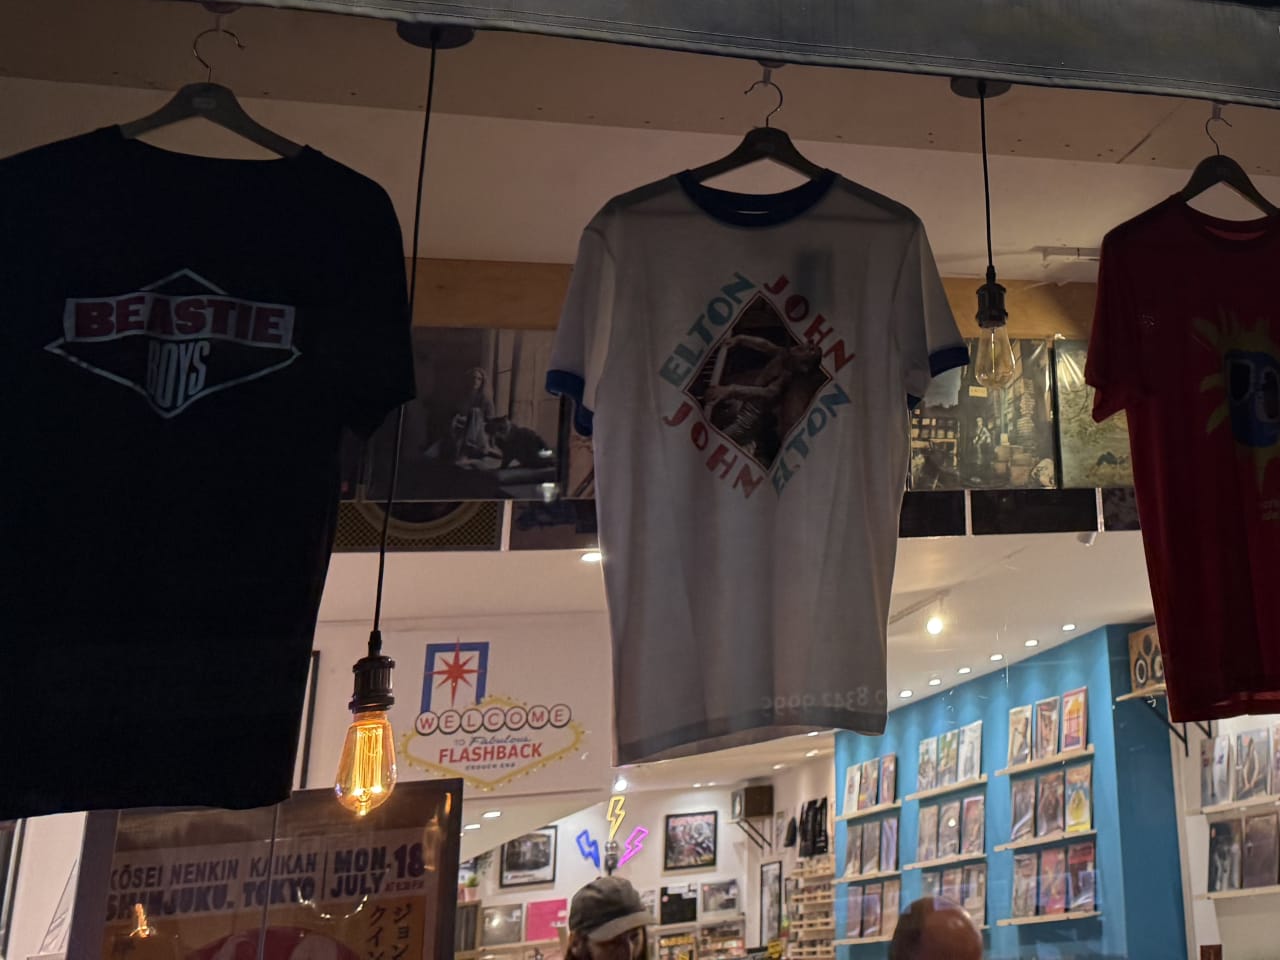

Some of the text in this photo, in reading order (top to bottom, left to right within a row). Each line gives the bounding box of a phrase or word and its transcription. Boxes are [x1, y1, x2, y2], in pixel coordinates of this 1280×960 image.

[74, 296, 285, 342] BEASTIE
[658, 271, 758, 387] ELTON
[763, 274, 857, 374] JOHN
[147, 341, 209, 411] BOYS
[662, 400, 768, 499] JOHN
[769, 382, 852, 496] ELTON
[419, 708, 565, 731] WELCOME
[439, 742, 543, 764] FLASHBACK
[169, 858, 240, 886] NENKIN
[333, 846, 392, 875] MON.
[394, 842, 425, 879] 18
[330, 872, 386, 898] JULY
